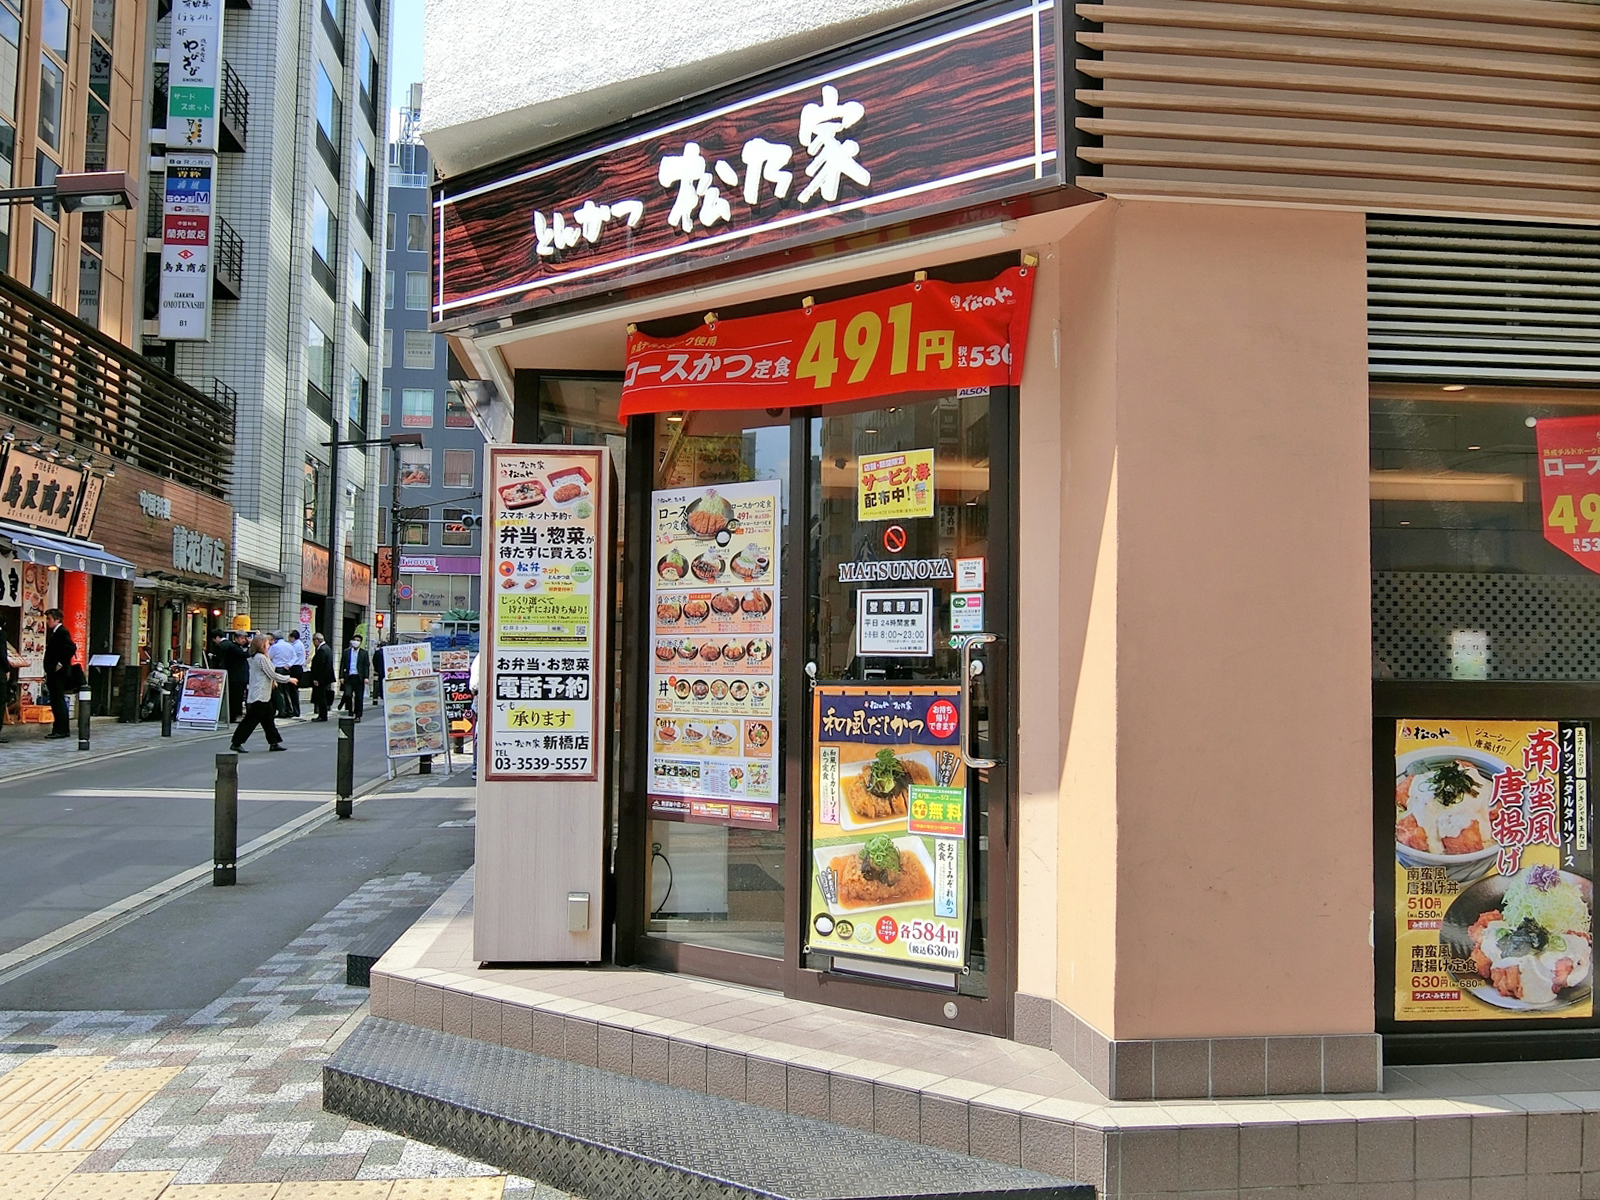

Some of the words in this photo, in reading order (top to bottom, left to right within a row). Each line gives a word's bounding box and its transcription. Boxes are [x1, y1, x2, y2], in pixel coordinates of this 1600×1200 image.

[181, 102, 210, 111] スポット
[534, 201, 643, 255] とんかつ
[659, 84, 872, 233] 松乃家
[166, 229, 206, 240] 蘭苑飯店
[163, 301, 205, 309] OMOTENASHI
[796, 303, 955, 389] 491円
[958, 386, 988, 396] ALSOK
[864, 486, 912, 508] 配布中!
[659, 505, 688, 520] ロース
[500, 526, 594, 545] 弁当・惣菜が
[173, 525, 225, 578] 蘭苑飯店
[499, 547, 592, 560] 待たずに買える!
[516, 561, 540, 573] 松弁
[839, 559, 953, 582] MATSUNOYA
[501, 596, 555, 606] じっくり選べて
[869, 600, 920, 613] 営業時間
[508, 605, 588, 615] 待たずにお持ち帰り!
[864, 618, 878, 627] 平日
[880, 618, 917, 627] 24時間営業
[391, 656, 412, 664] ¥500
[497, 658, 590, 671] お弁当・お惣菜
[411, 668, 431, 676] ¥700
[443, 682, 466, 692] ランチ
[497, 676, 588, 699] 電話予約
[659, 680, 669, 696] 丼
[932, 705, 952, 714] お持ち
[512, 711, 571, 727] 承ります
[822, 707, 925, 737] 和風だしかつ
[929, 722, 956, 731] できます
[1413, 727, 1450, 740] 松のや
[1475, 728, 1512, 743] ジューシー
[543, 736, 590, 750] 新橋店
[495, 757, 588, 770] 03-3539-5557
[1522, 727, 1561, 847] 南蛮風
[1562, 729, 1575, 868] フレッシュタルタルソース
[929, 802, 962, 822] 無料
[1489, 765, 1526, 876] 唐揚げ
[937, 842, 946, 861] 定食
[946, 843, 954, 914] おろしみぞれかつ
[1406, 866, 1447, 880] 南蛮風
[1406, 881, 1459, 895] 唐揚げ丼
[1407, 897, 1441, 909] 510円
[900, 921, 959, 944] 各584円
[1411, 944, 1451, 959] 南蛮風
[1411, 959, 1477, 973] 唐揚げ定食
[1411, 976, 1448, 988] 630円
